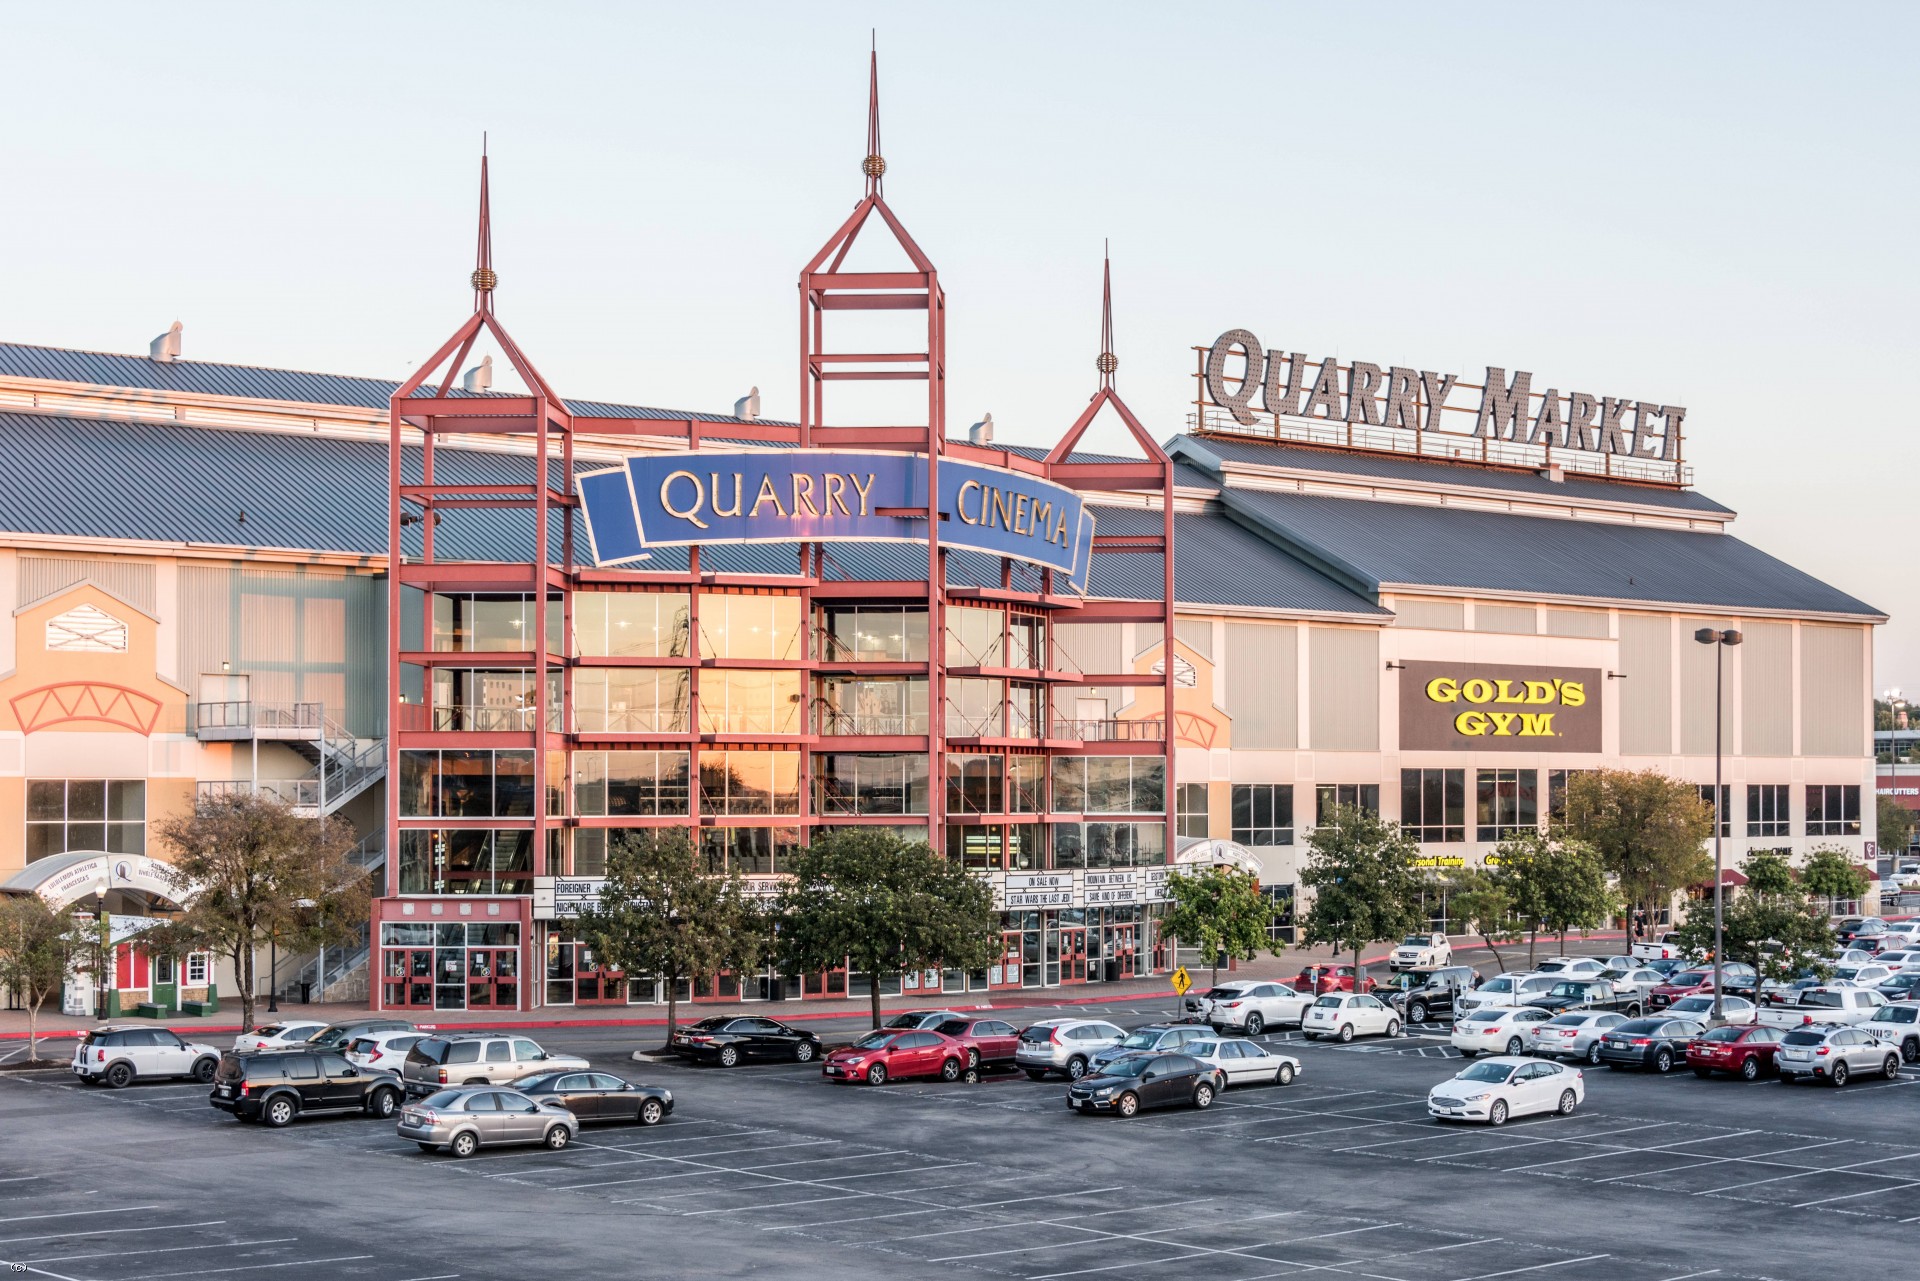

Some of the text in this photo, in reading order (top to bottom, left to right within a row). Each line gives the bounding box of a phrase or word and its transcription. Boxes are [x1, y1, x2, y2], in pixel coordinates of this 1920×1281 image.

[1205, 328, 1687, 461] QUARRY MARKET
[660, 470, 1070, 549] QUARRY CINEMA
[1425, 677, 1586, 707] GOLD'S
[1437, 855, 1465, 868] Training
[556, 883, 591, 893] FOREIGNER
[1028, 876, 1059, 887] ON SALE NOW
[1010, 892, 1071, 904] STAR WARS THE LAST JEDI
